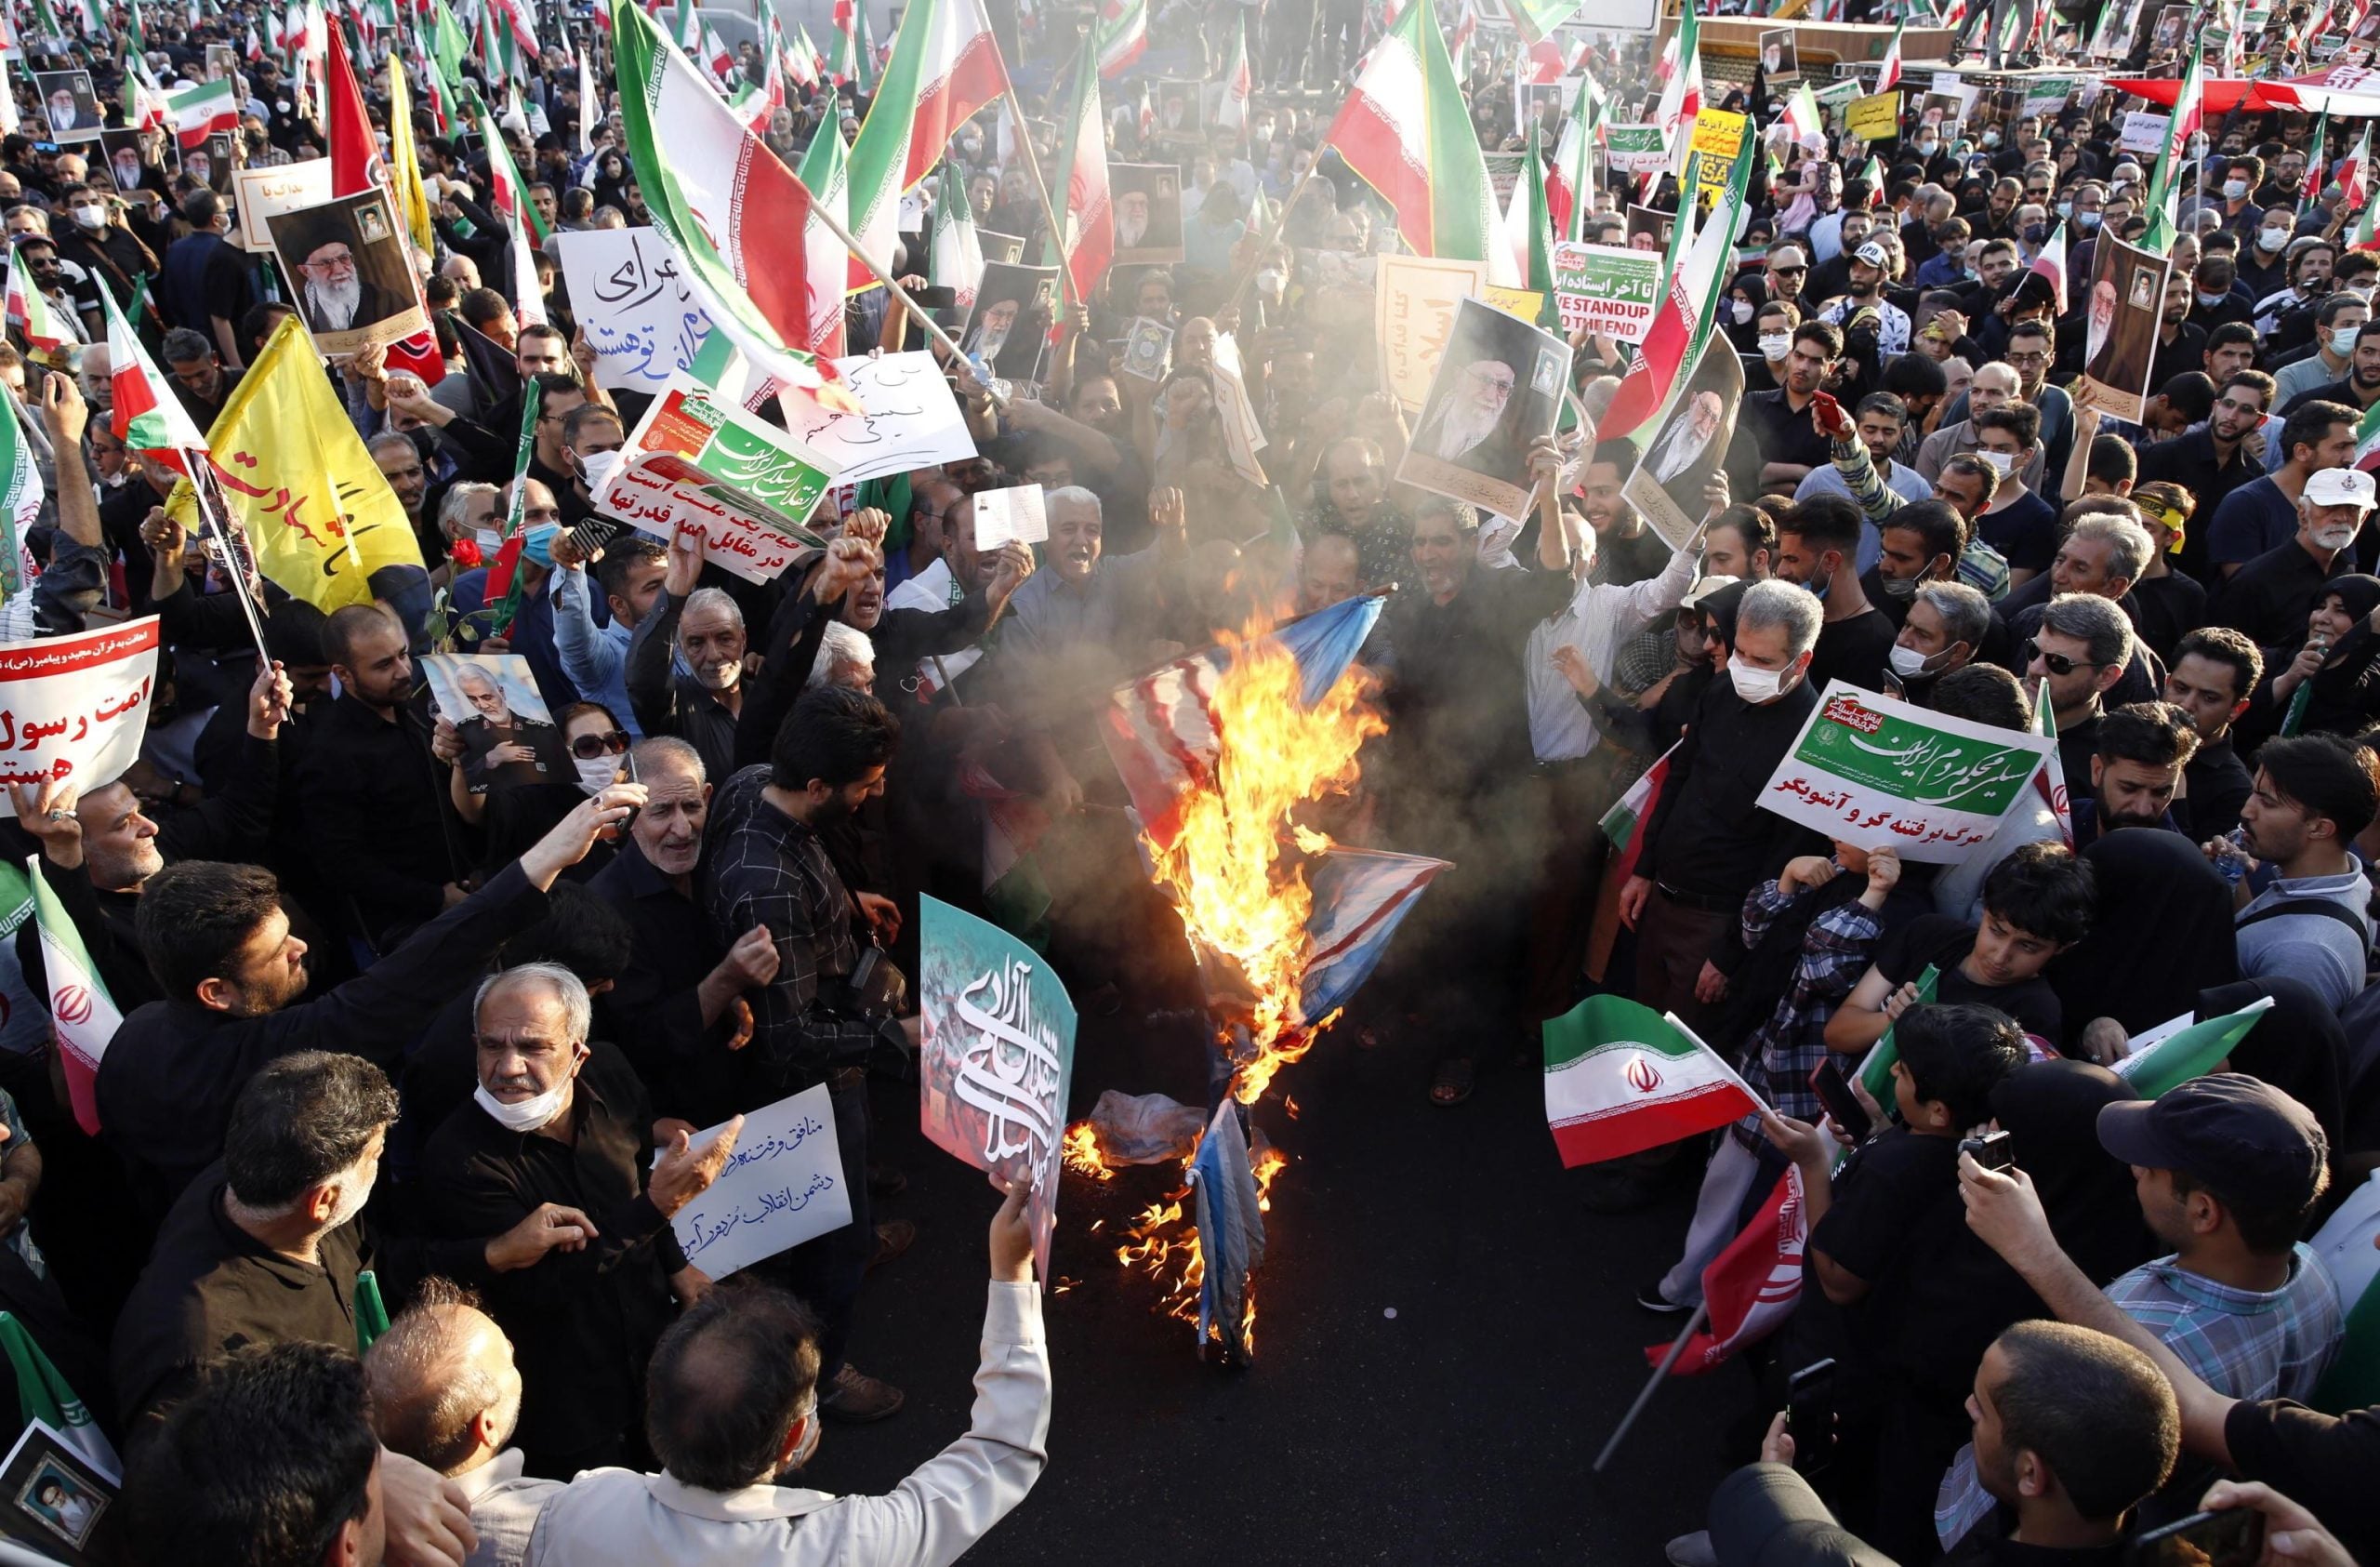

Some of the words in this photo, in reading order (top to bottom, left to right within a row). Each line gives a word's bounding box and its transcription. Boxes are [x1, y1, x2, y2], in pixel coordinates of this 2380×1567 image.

[1700, 161, 1727, 185] SA
[1567, 273, 1611, 297] ایستاده
[1610, 278, 1642, 299] آخر
[1641, 282, 1653, 299] تا
[1573, 298, 1626, 316] STAND
[1627, 305, 1649, 319] UP
[1605, 320, 1637, 336] END
[626, 471, 674, 492] است
[672, 490, 727, 517] ملت
[729, 515, 760, 535] یک
[708, 531, 758, 558] مقابل
[755, 555, 785, 568] در
[116, 640, 126, 649] به
[126, 631, 148, 646] اهانت
[69, 648, 92, 662] مجید
[93, 642, 116, 657] قرآن
[95, 674, 151, 723] امت
[0, 710, 88, 751] رسول
[1774, 777, 1854, 810] آشوبگر
[1844, 808, 1860, 822] و
[1858, 812, 1891, 829] گر
[1889, 817, 1926, 839] فتنه
[1919, 830, 1943, 843] بر
[1943, 826, 1983, 847] مرگ
[786, 1117, 823, 1150] منافق
[790, 1174, 833, 1211] دشمن
[743, 1187, 792, 1224] انقلاب
